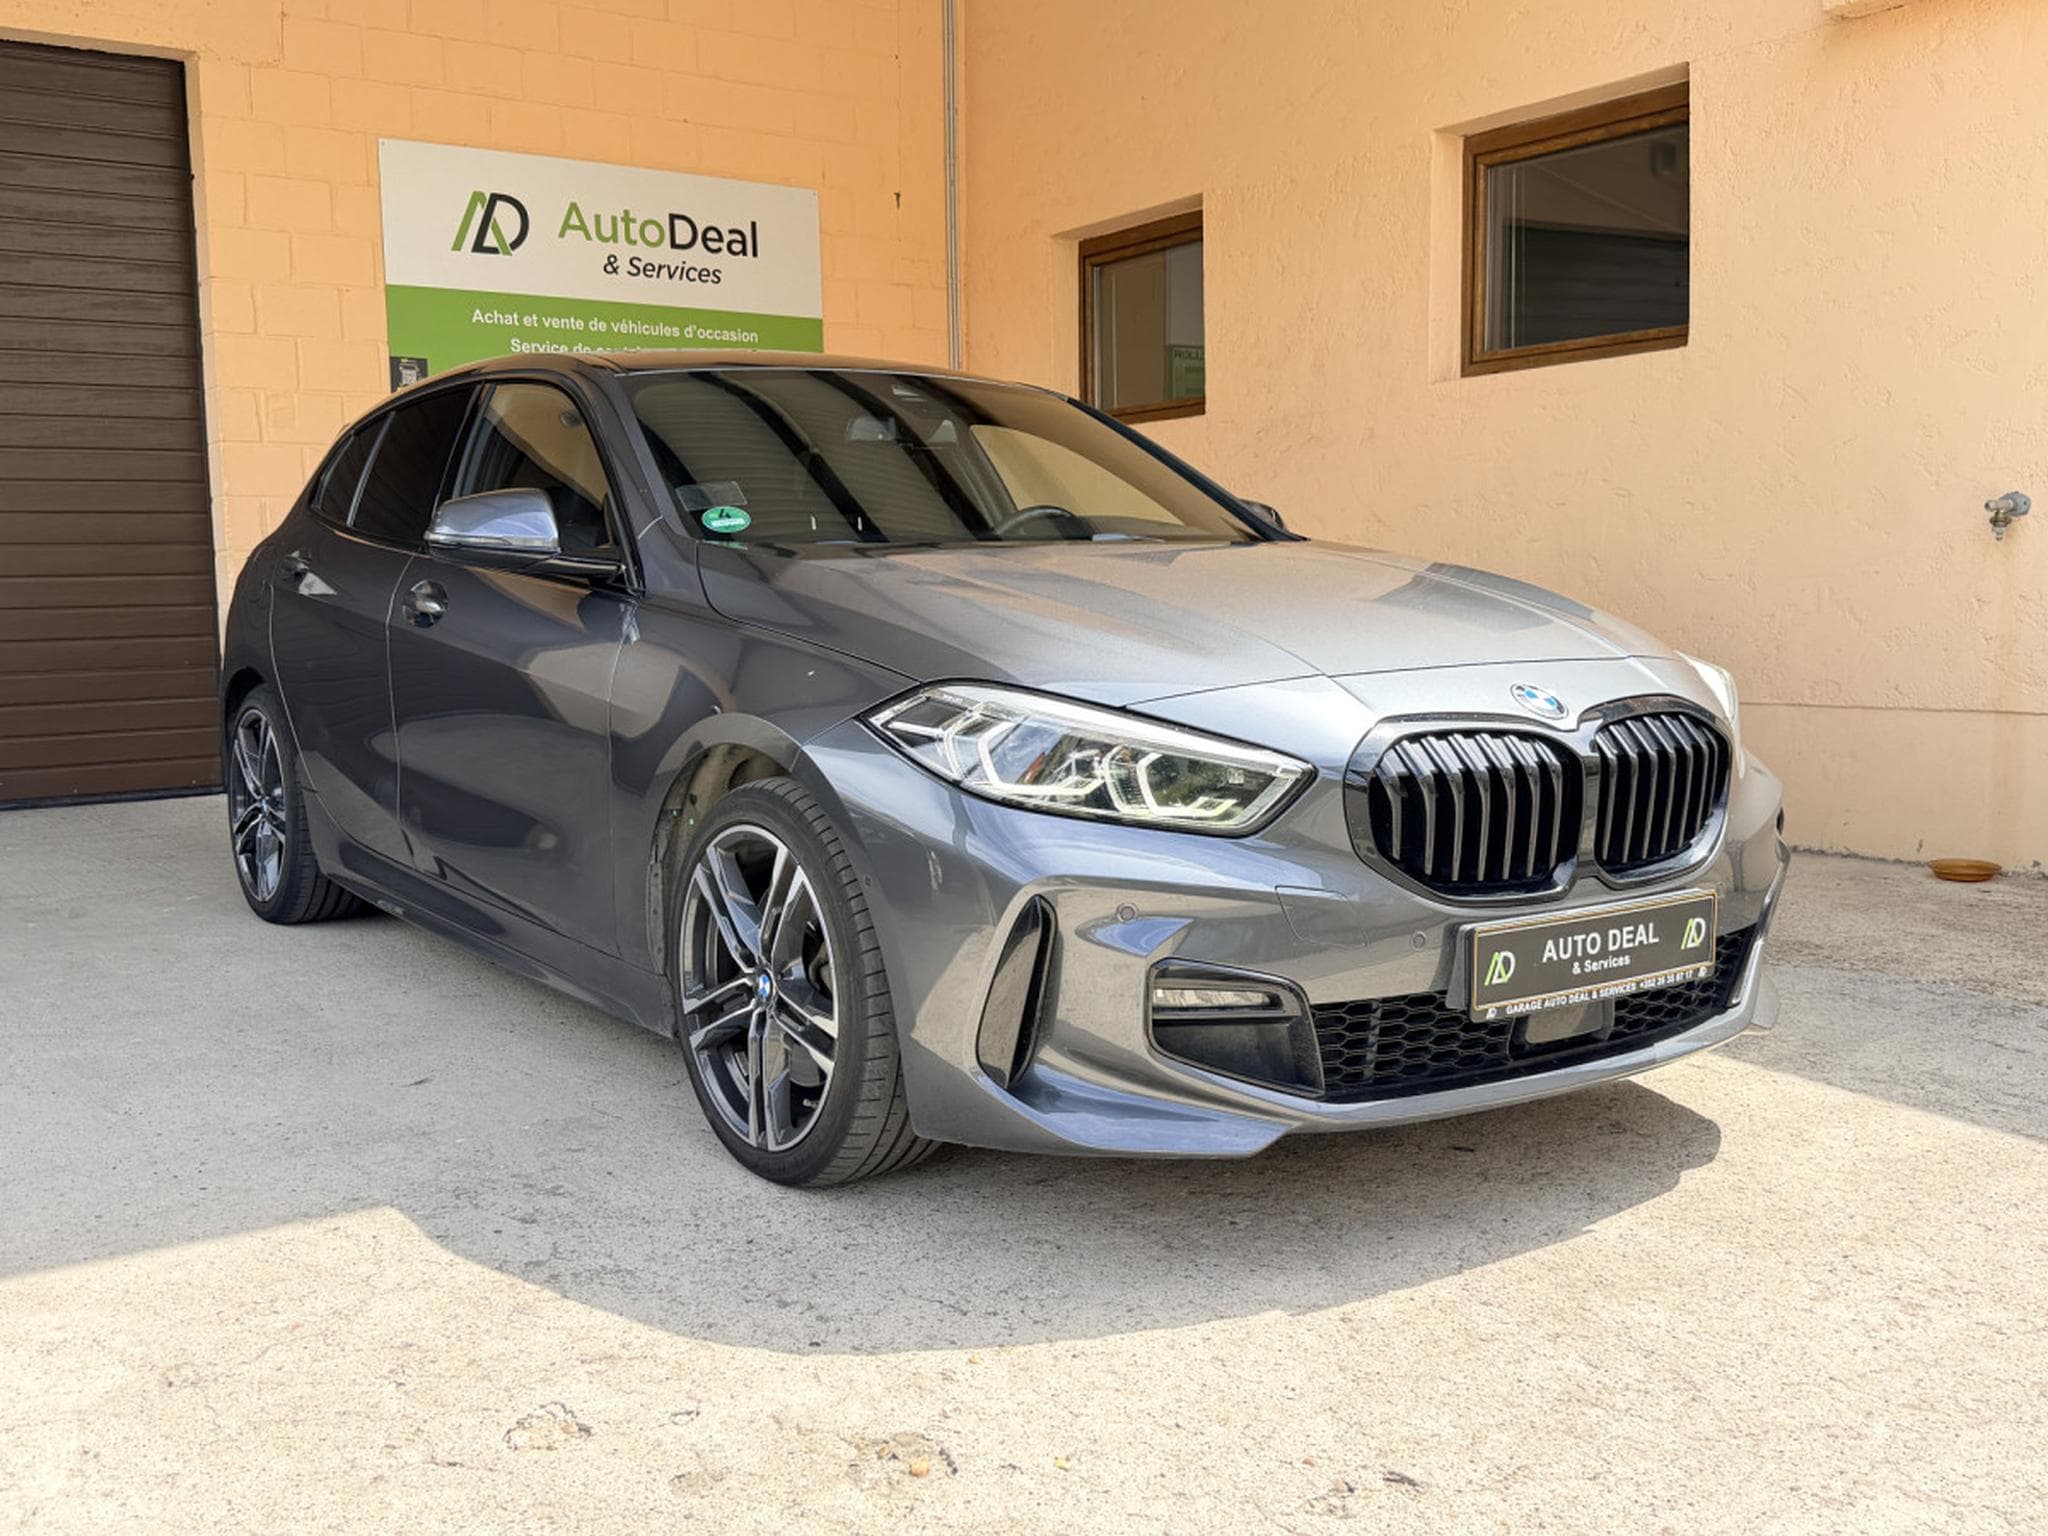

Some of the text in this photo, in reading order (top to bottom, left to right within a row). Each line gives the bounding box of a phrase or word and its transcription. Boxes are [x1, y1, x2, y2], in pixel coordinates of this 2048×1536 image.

[558, 202, 758, 258] AutoDeal
[603, 254, 722, 284] & Services
[472, 309, 759, 343] Achat et vente de véhicules d'occasion
[510, 338, 568, 353] Service
[1542, 922, 1659, 963] AUTO DEAL
[1572, 955, 1631, 975] & Services
[1506, 1001, 1542, 1015] GARAGE
[1544, 996, 1568, 1008] AUTO
[1569, 992, 1590, 1004] DEAL
